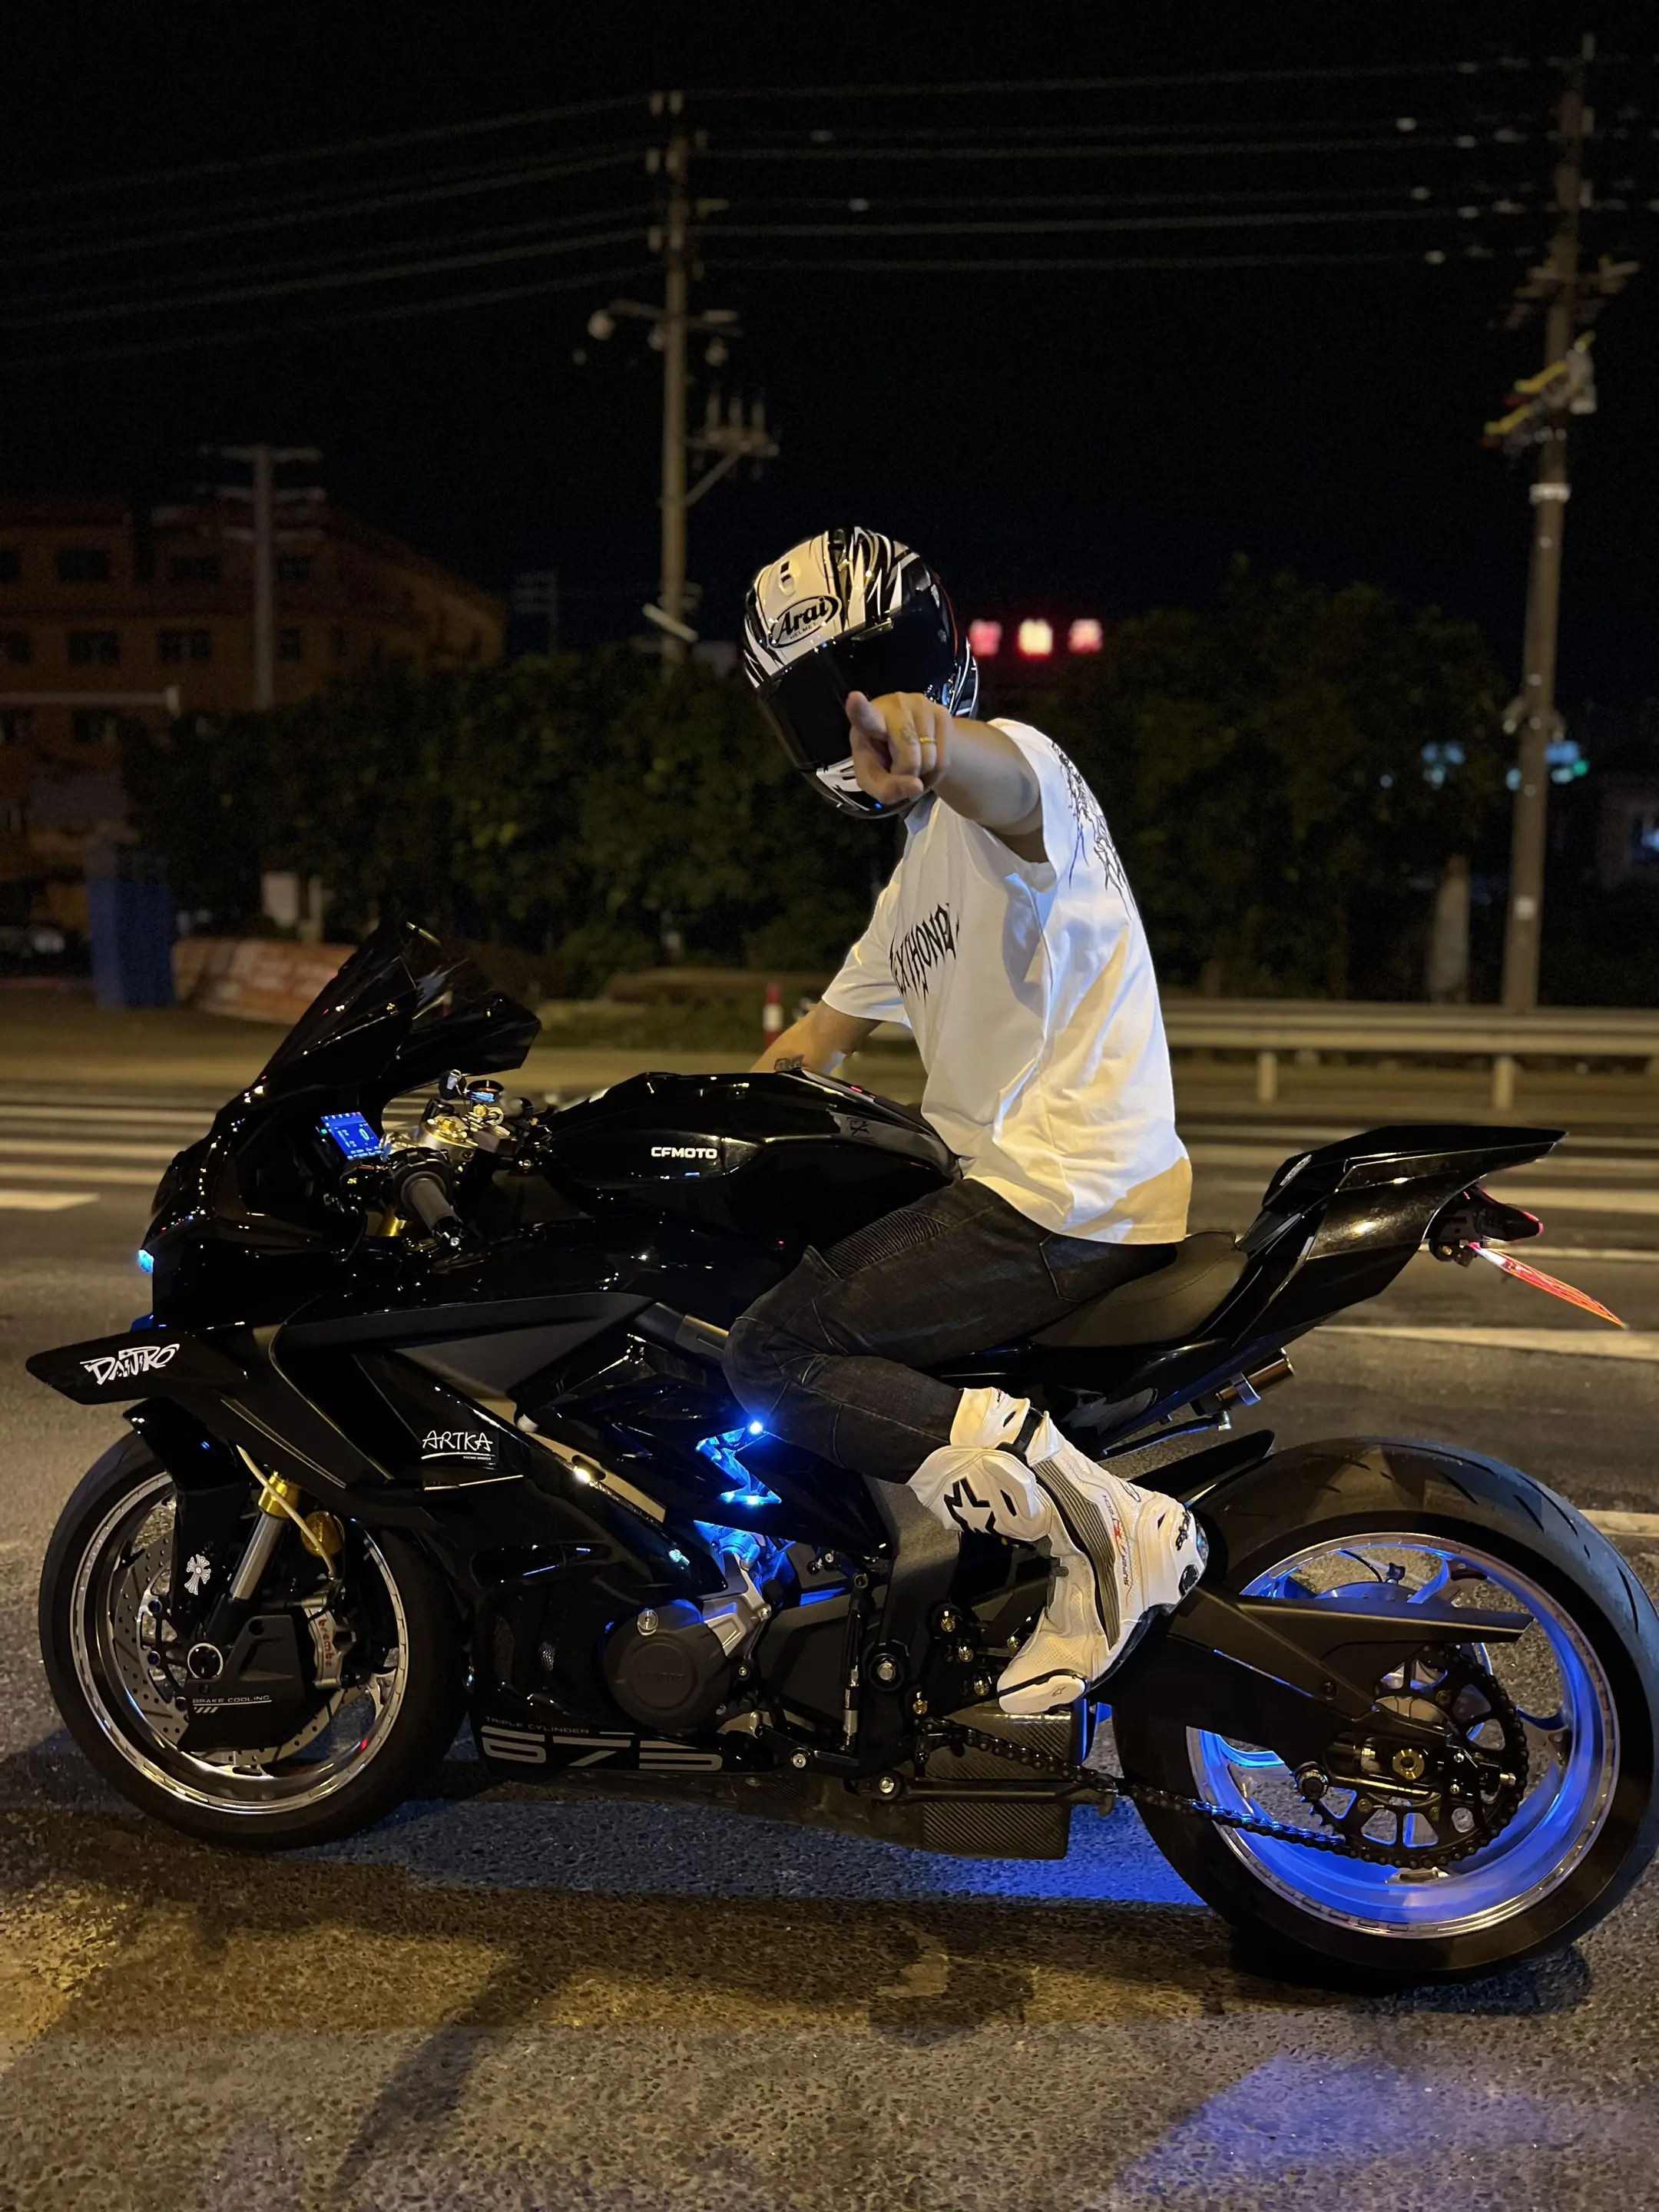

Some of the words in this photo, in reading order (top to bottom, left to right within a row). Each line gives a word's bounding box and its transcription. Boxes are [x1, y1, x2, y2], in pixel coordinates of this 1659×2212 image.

[777, 597, 830, 644] Arai
[651, 1147, 718, 1160] CFMOTO
[422, 1429, 494, 1452] ARTKA
[227, 1694, 270, 1703] COOLING
[484, 1715, 524, 1728] TRIPLE
[528, 1723, 590, 1735] CYLINDER
[481, 1725, 723, 1771] 675
